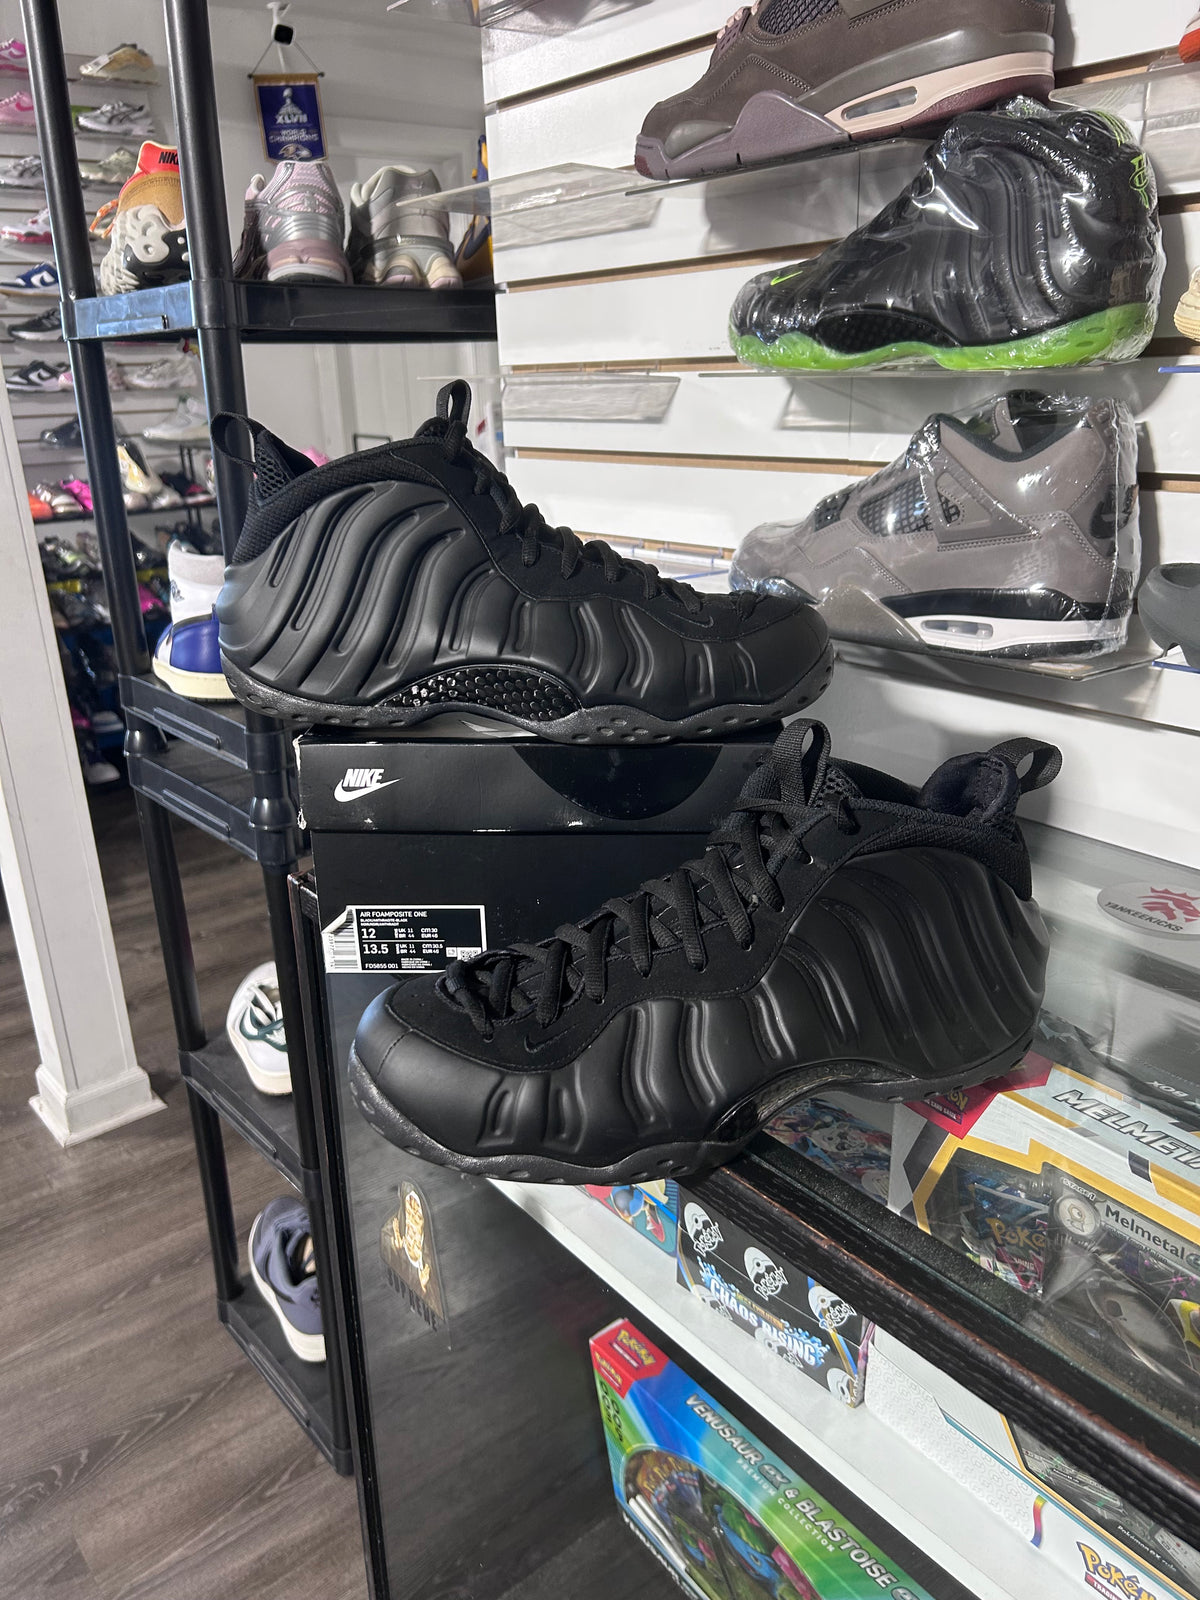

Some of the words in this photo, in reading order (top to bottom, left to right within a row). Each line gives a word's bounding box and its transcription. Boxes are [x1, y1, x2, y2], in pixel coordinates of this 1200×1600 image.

[158, 151, 179, 166] NIK
[342, 768, 385, 788] NIKE
[1104, 901, 1183, 932] YANKEEKICKS
[361, 928, 377, 939] 12
[363, 943, 389, 954] 13.5
[984, 1218, 1047, 1251] Poké
[1105, 1204, 1185, 1260] Melmetal
[710, 1278, 758, 1327] CHAOS
[761, 1317, 816, 1366] RISING
[686, 1393, 764, 1466] VENUSAUR
[784, 1487, 800, 1501] &
[794, 1498, 898, 1589] BLASTOISE
[736, 1458, 777, 1497] PREMIUM
[777, 1497, 835, 1553] COLLECTION
[1076, 1541, 1157, 1600] Poké
